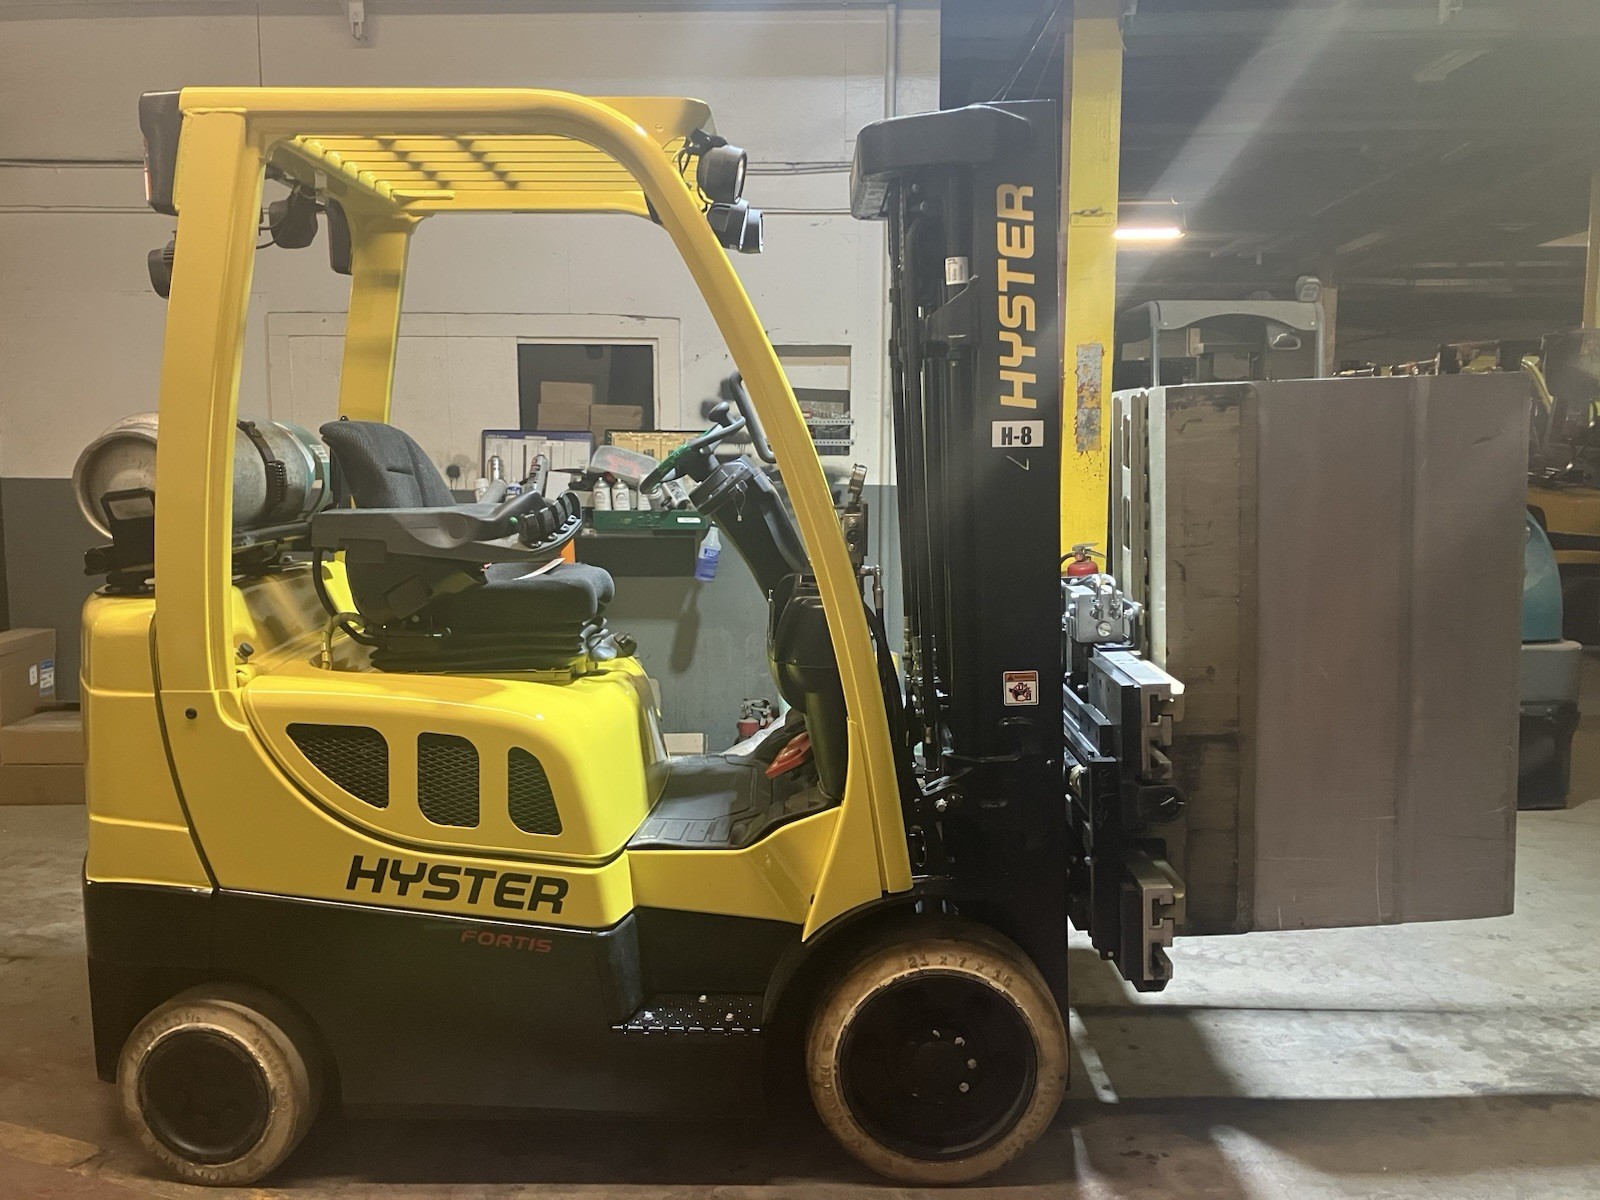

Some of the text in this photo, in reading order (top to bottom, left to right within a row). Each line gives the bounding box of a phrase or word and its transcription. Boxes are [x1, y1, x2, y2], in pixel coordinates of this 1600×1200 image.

[996, 183, 1036, 409] HYSTER
[1001, 426, 1032, 446] H-8
[346, 855, 569, 914] HYSTER
[461, 930, 553, 953] FORTIS
